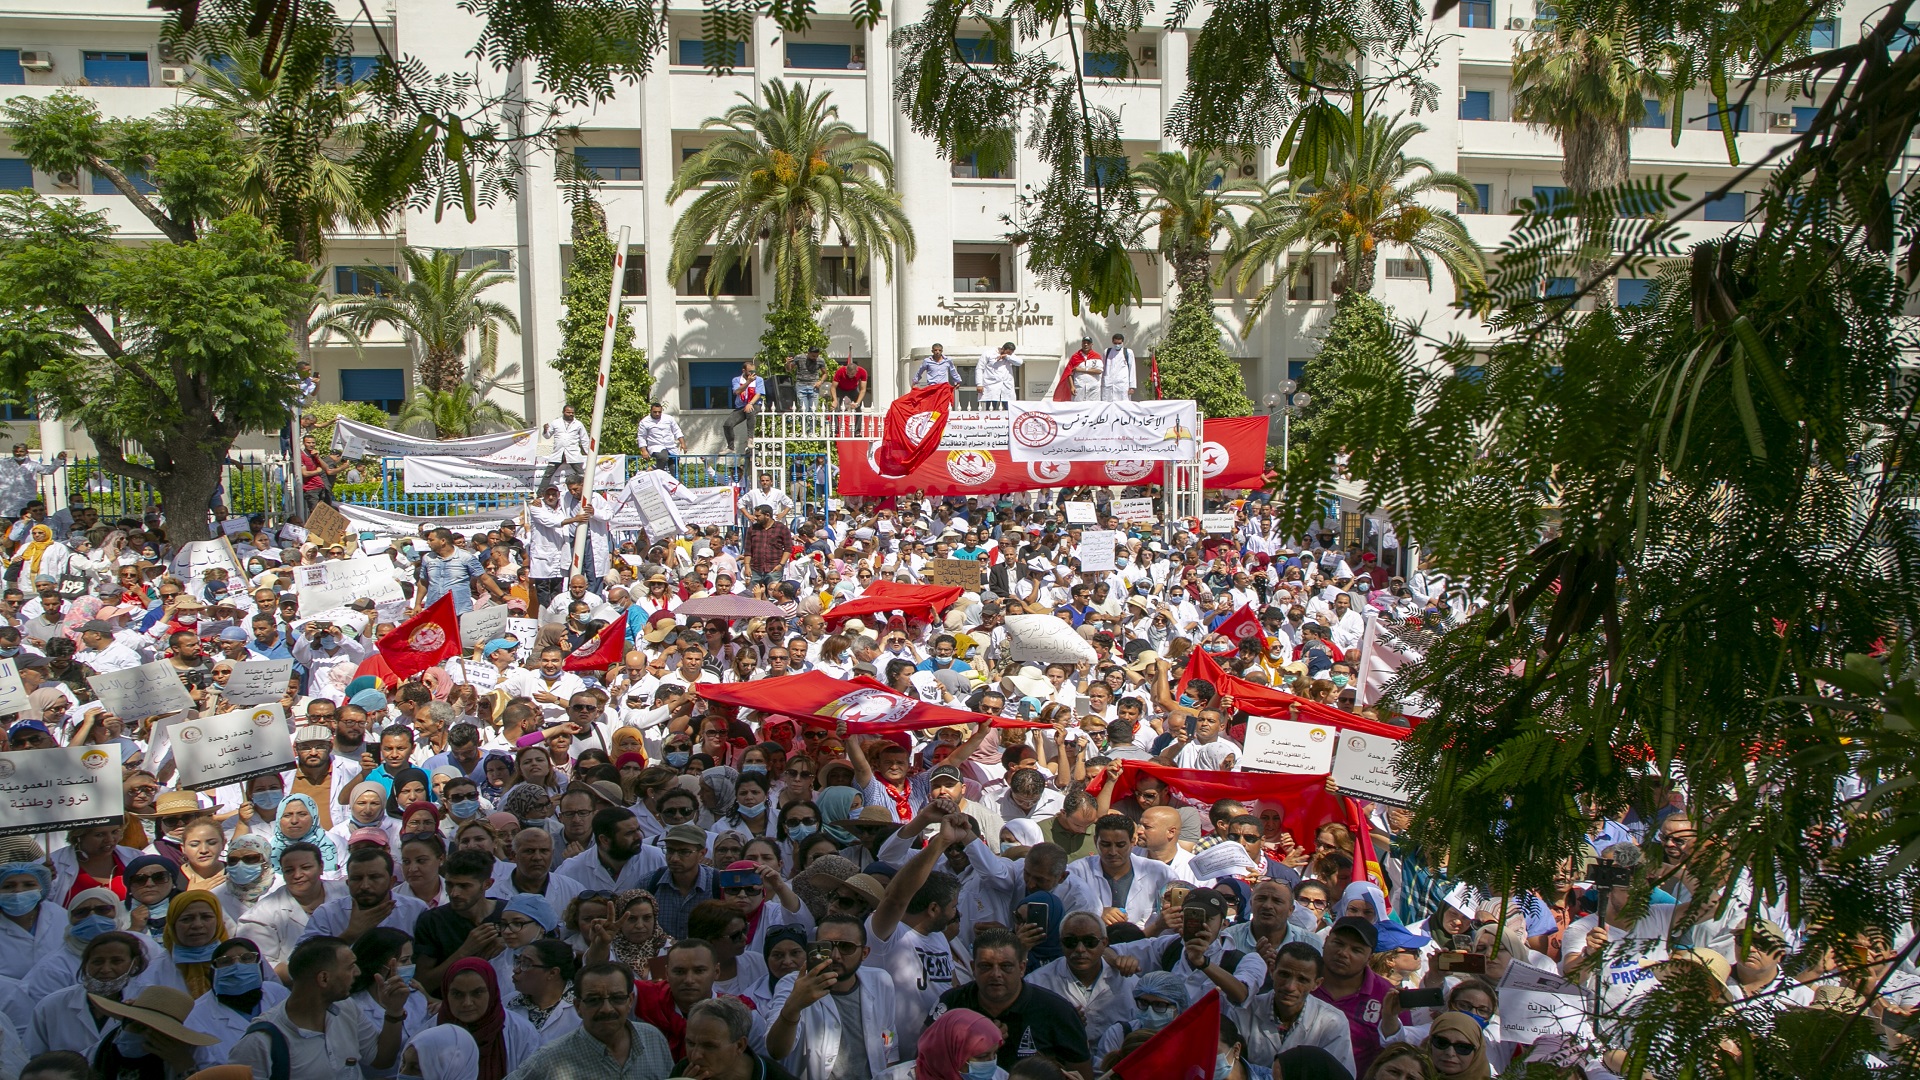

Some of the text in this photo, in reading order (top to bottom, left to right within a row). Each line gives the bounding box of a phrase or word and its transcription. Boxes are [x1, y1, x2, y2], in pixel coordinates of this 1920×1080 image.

[996, 297, 1040, 314] وزارة
[917, 315, 1054, 327] MINISTERE DE LA SANTE
[1062, 414, 1089, 430] تونس
[1089, 414, 1109, 429] لطلبة
[1112, 415, 1136, 432] العام
[58, 793, 90, 807] ثروة
